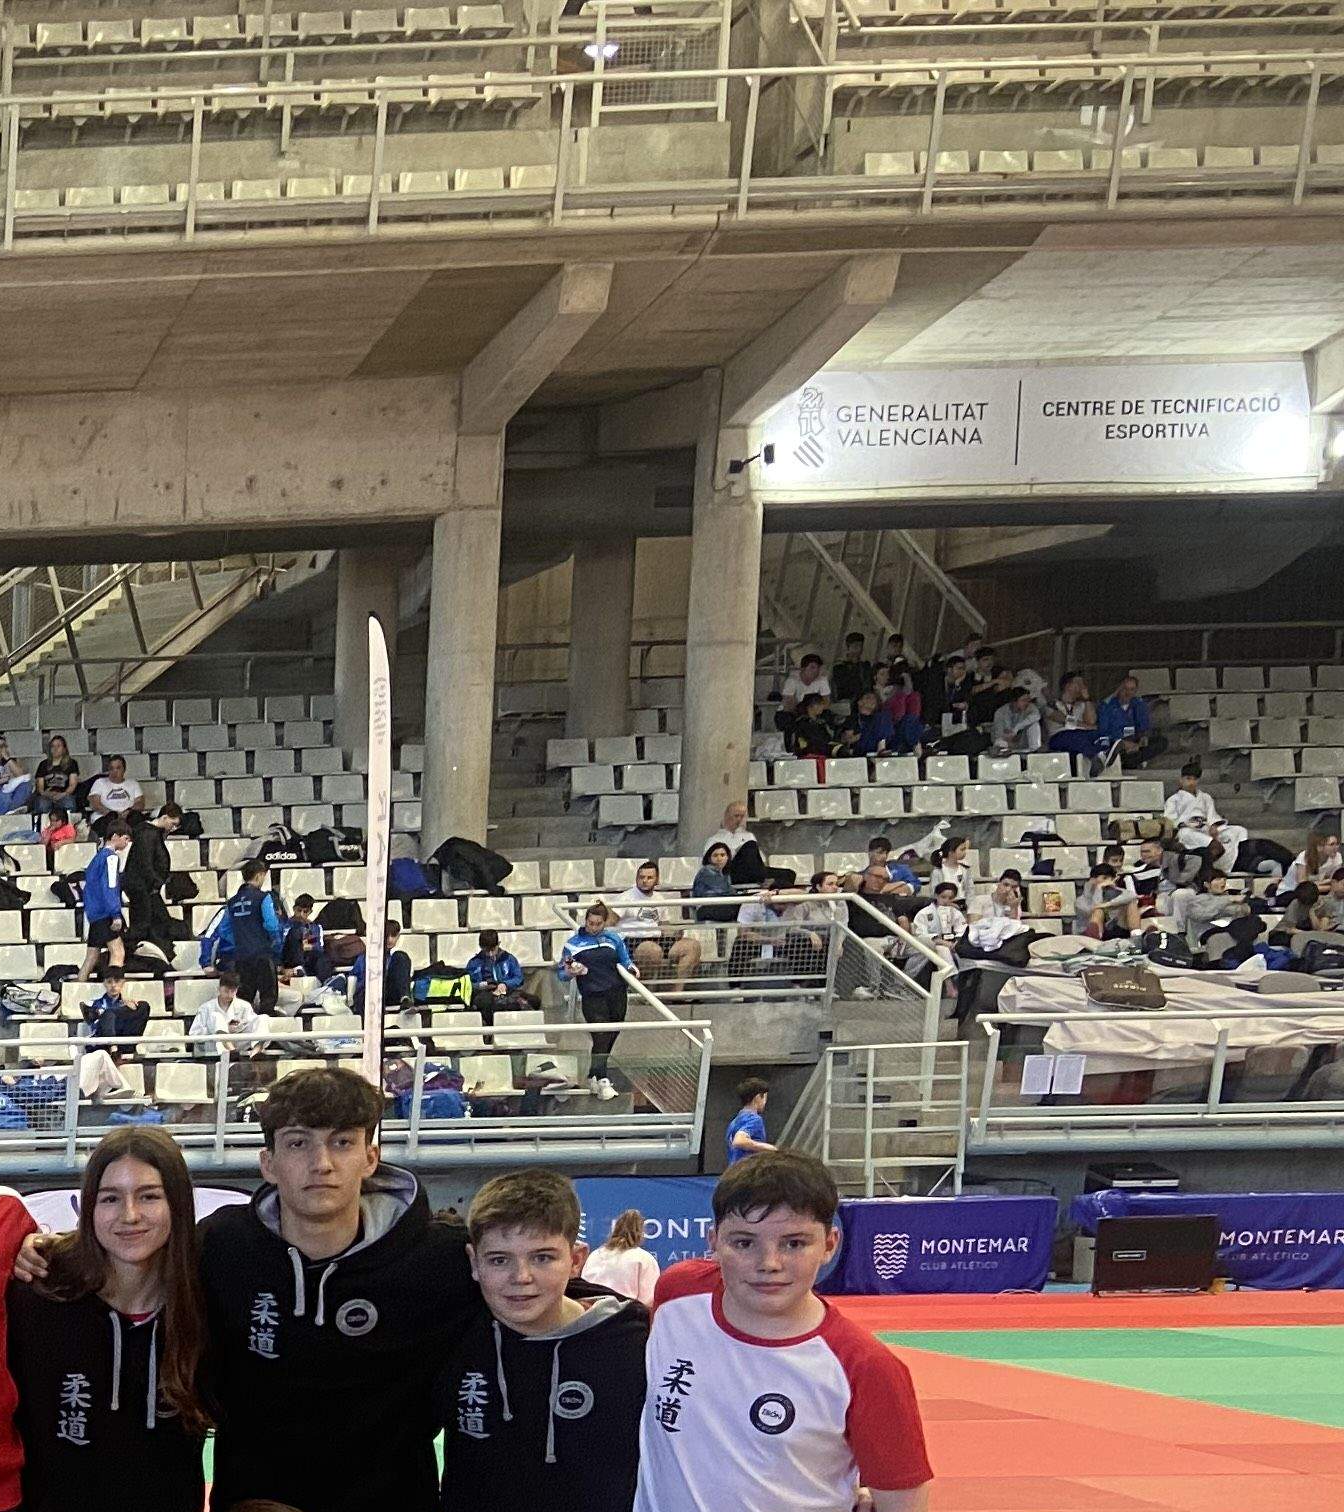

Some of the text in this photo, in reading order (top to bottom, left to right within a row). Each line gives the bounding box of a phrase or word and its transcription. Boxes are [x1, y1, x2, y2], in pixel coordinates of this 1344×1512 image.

[836, 402, 989, 424] GENERALITAT
[1043, 393, 1281, 418] CENTRE DE TECNIFICACIÓ
[838, 427, 984, 448] VALENCIANA
[1104, 422, 1210, 441] ESPORTIVA
[920, 1236, 1029, 1255] MONTEMAR
[1219, 1229, 1344, 1246] MONTEMAR
[457, 1371, 491, 1439] 柔道
[655, 1357, 697, 1434] 柔道
[56, 1372, 93, 1446] 柔道
